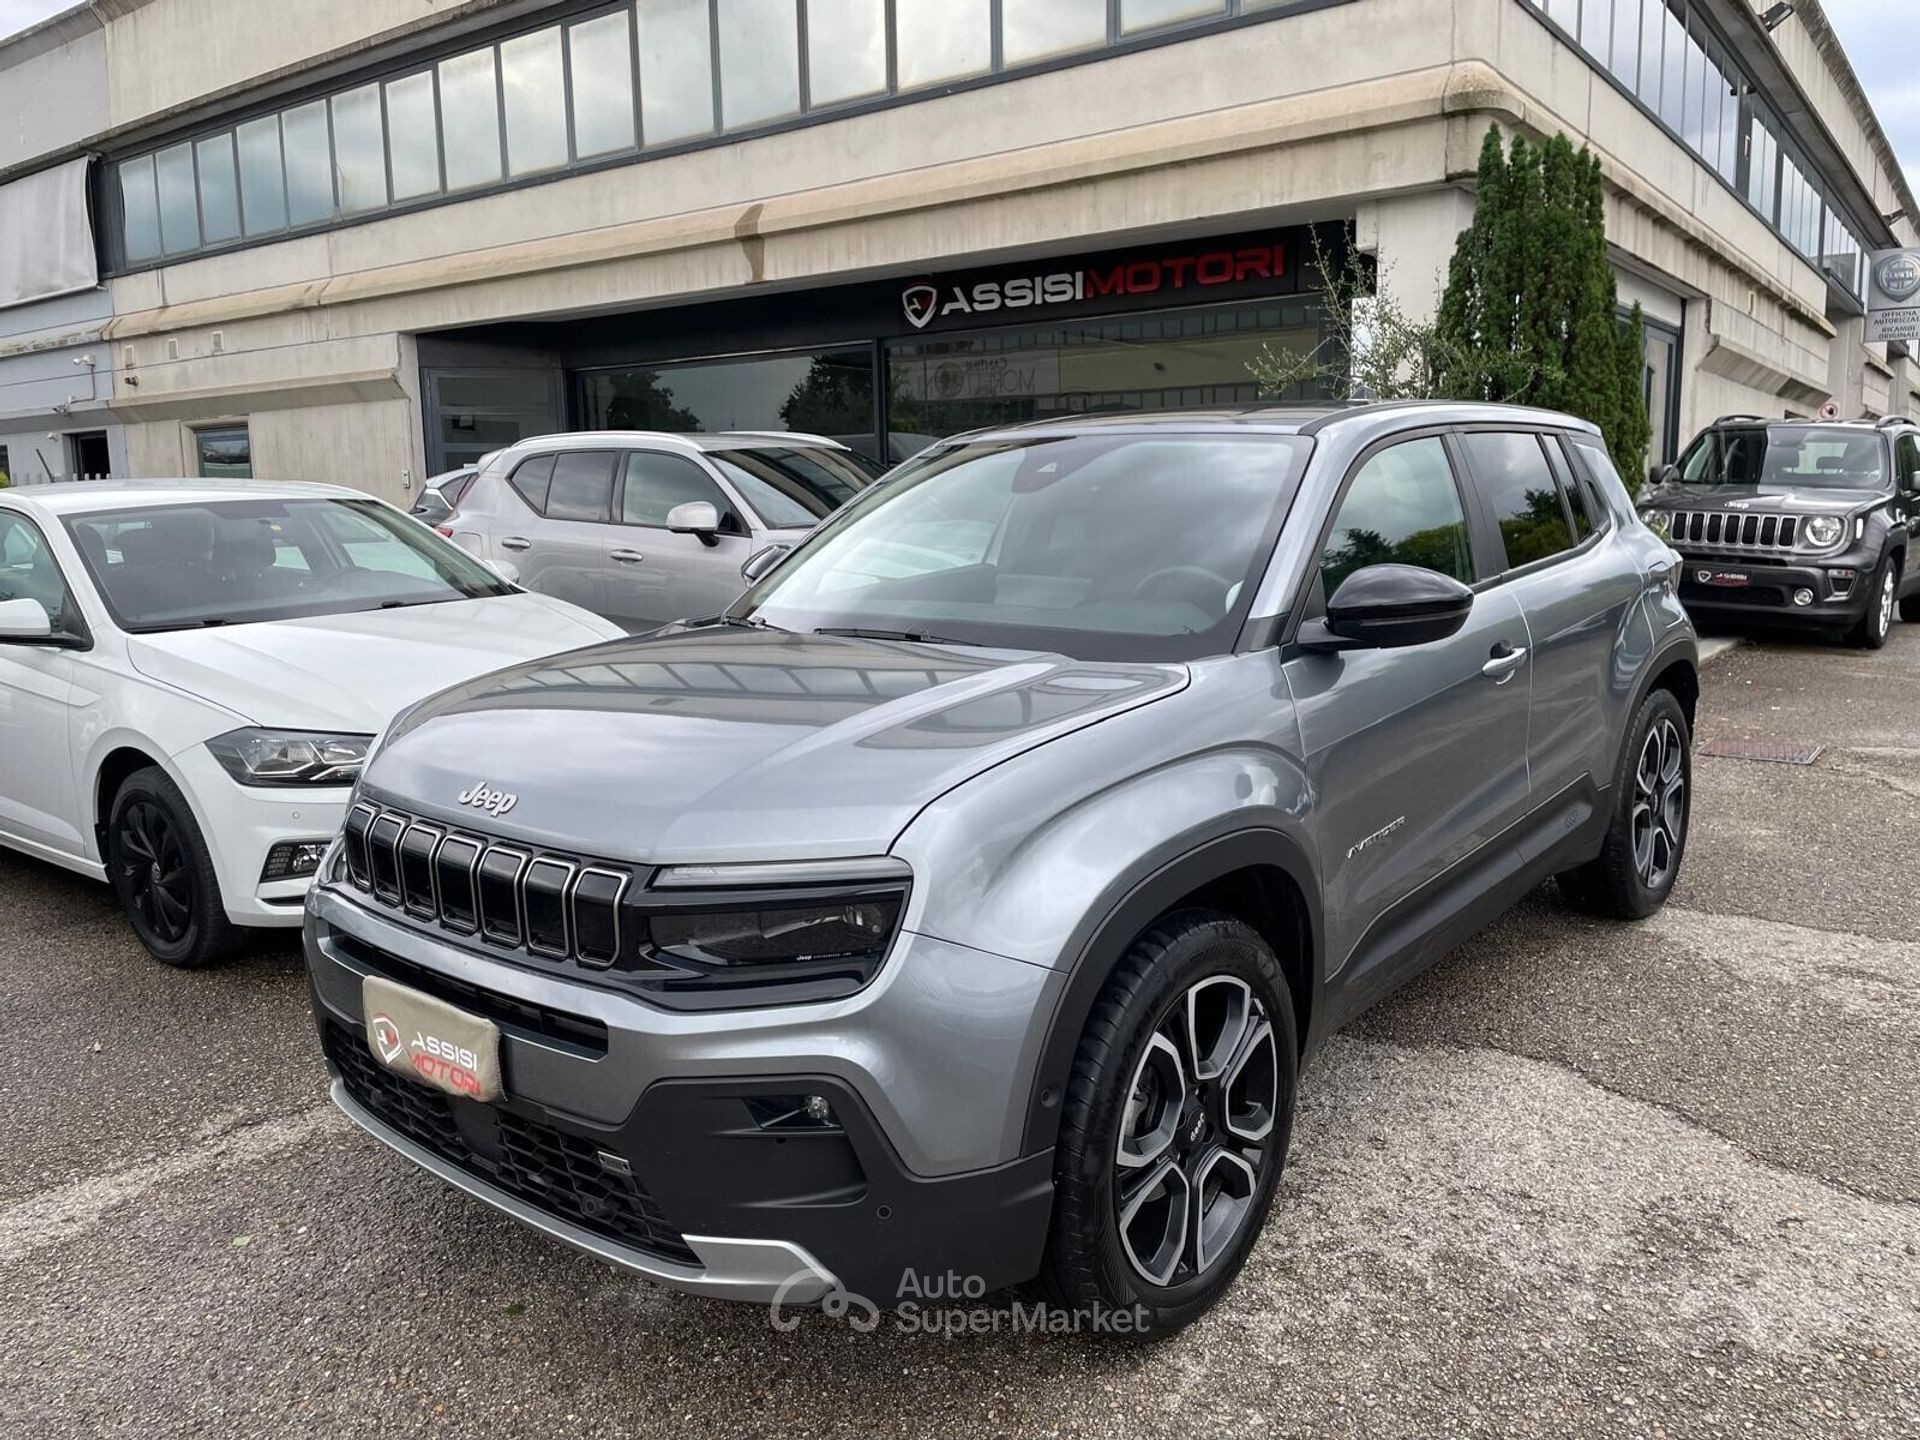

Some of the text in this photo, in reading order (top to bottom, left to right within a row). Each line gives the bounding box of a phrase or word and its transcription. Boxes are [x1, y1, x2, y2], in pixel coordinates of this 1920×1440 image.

[1881, 310, 1917, 318] OFFICINA
[1873, 316, 1920, 326] AUTORIZZAT
[1881, 325, 1916, 333] RICAMBI
[1878, 331, 1919, 340] ORIGINALI
[458, 781, 518, 818] Jeep
[411, 1031, 478, 1071] ASSISI
